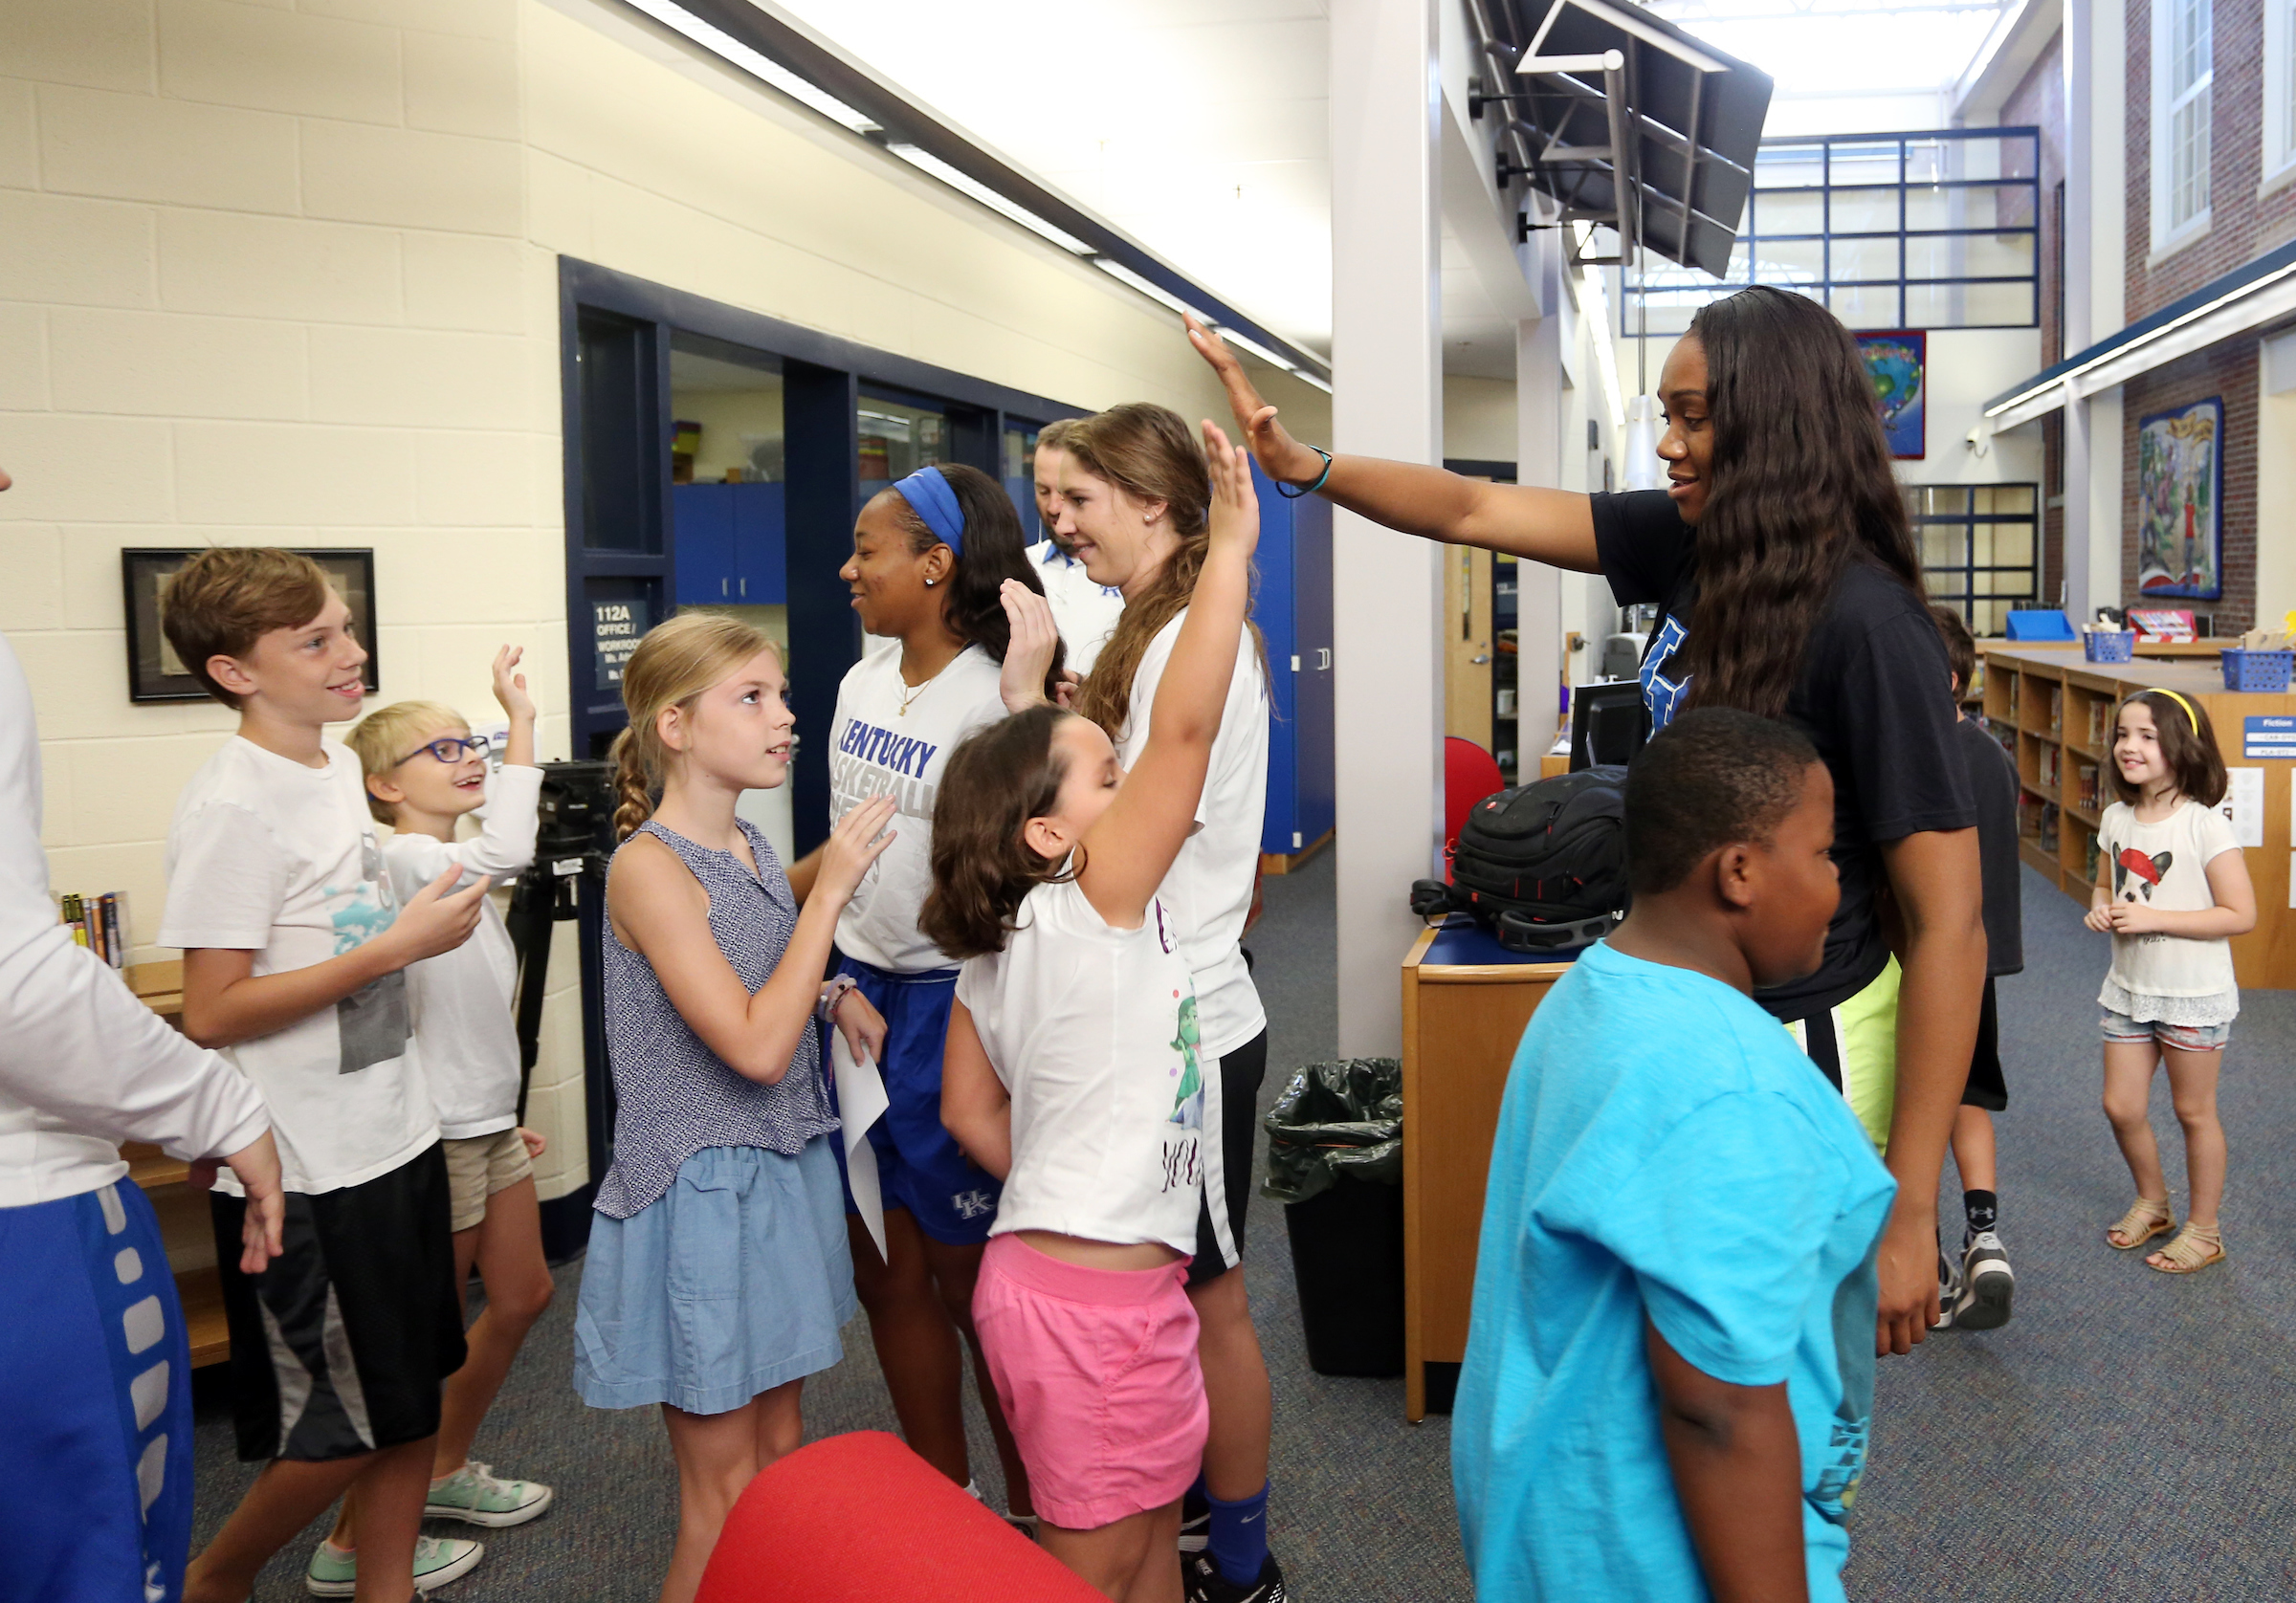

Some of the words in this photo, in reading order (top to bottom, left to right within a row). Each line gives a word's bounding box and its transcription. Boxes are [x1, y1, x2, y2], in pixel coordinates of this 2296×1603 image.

[596, 605, 630, 622] 112A
[596, 623, 631, 636] OFFICE
[2263, 718, 2293, 727] Fiction
